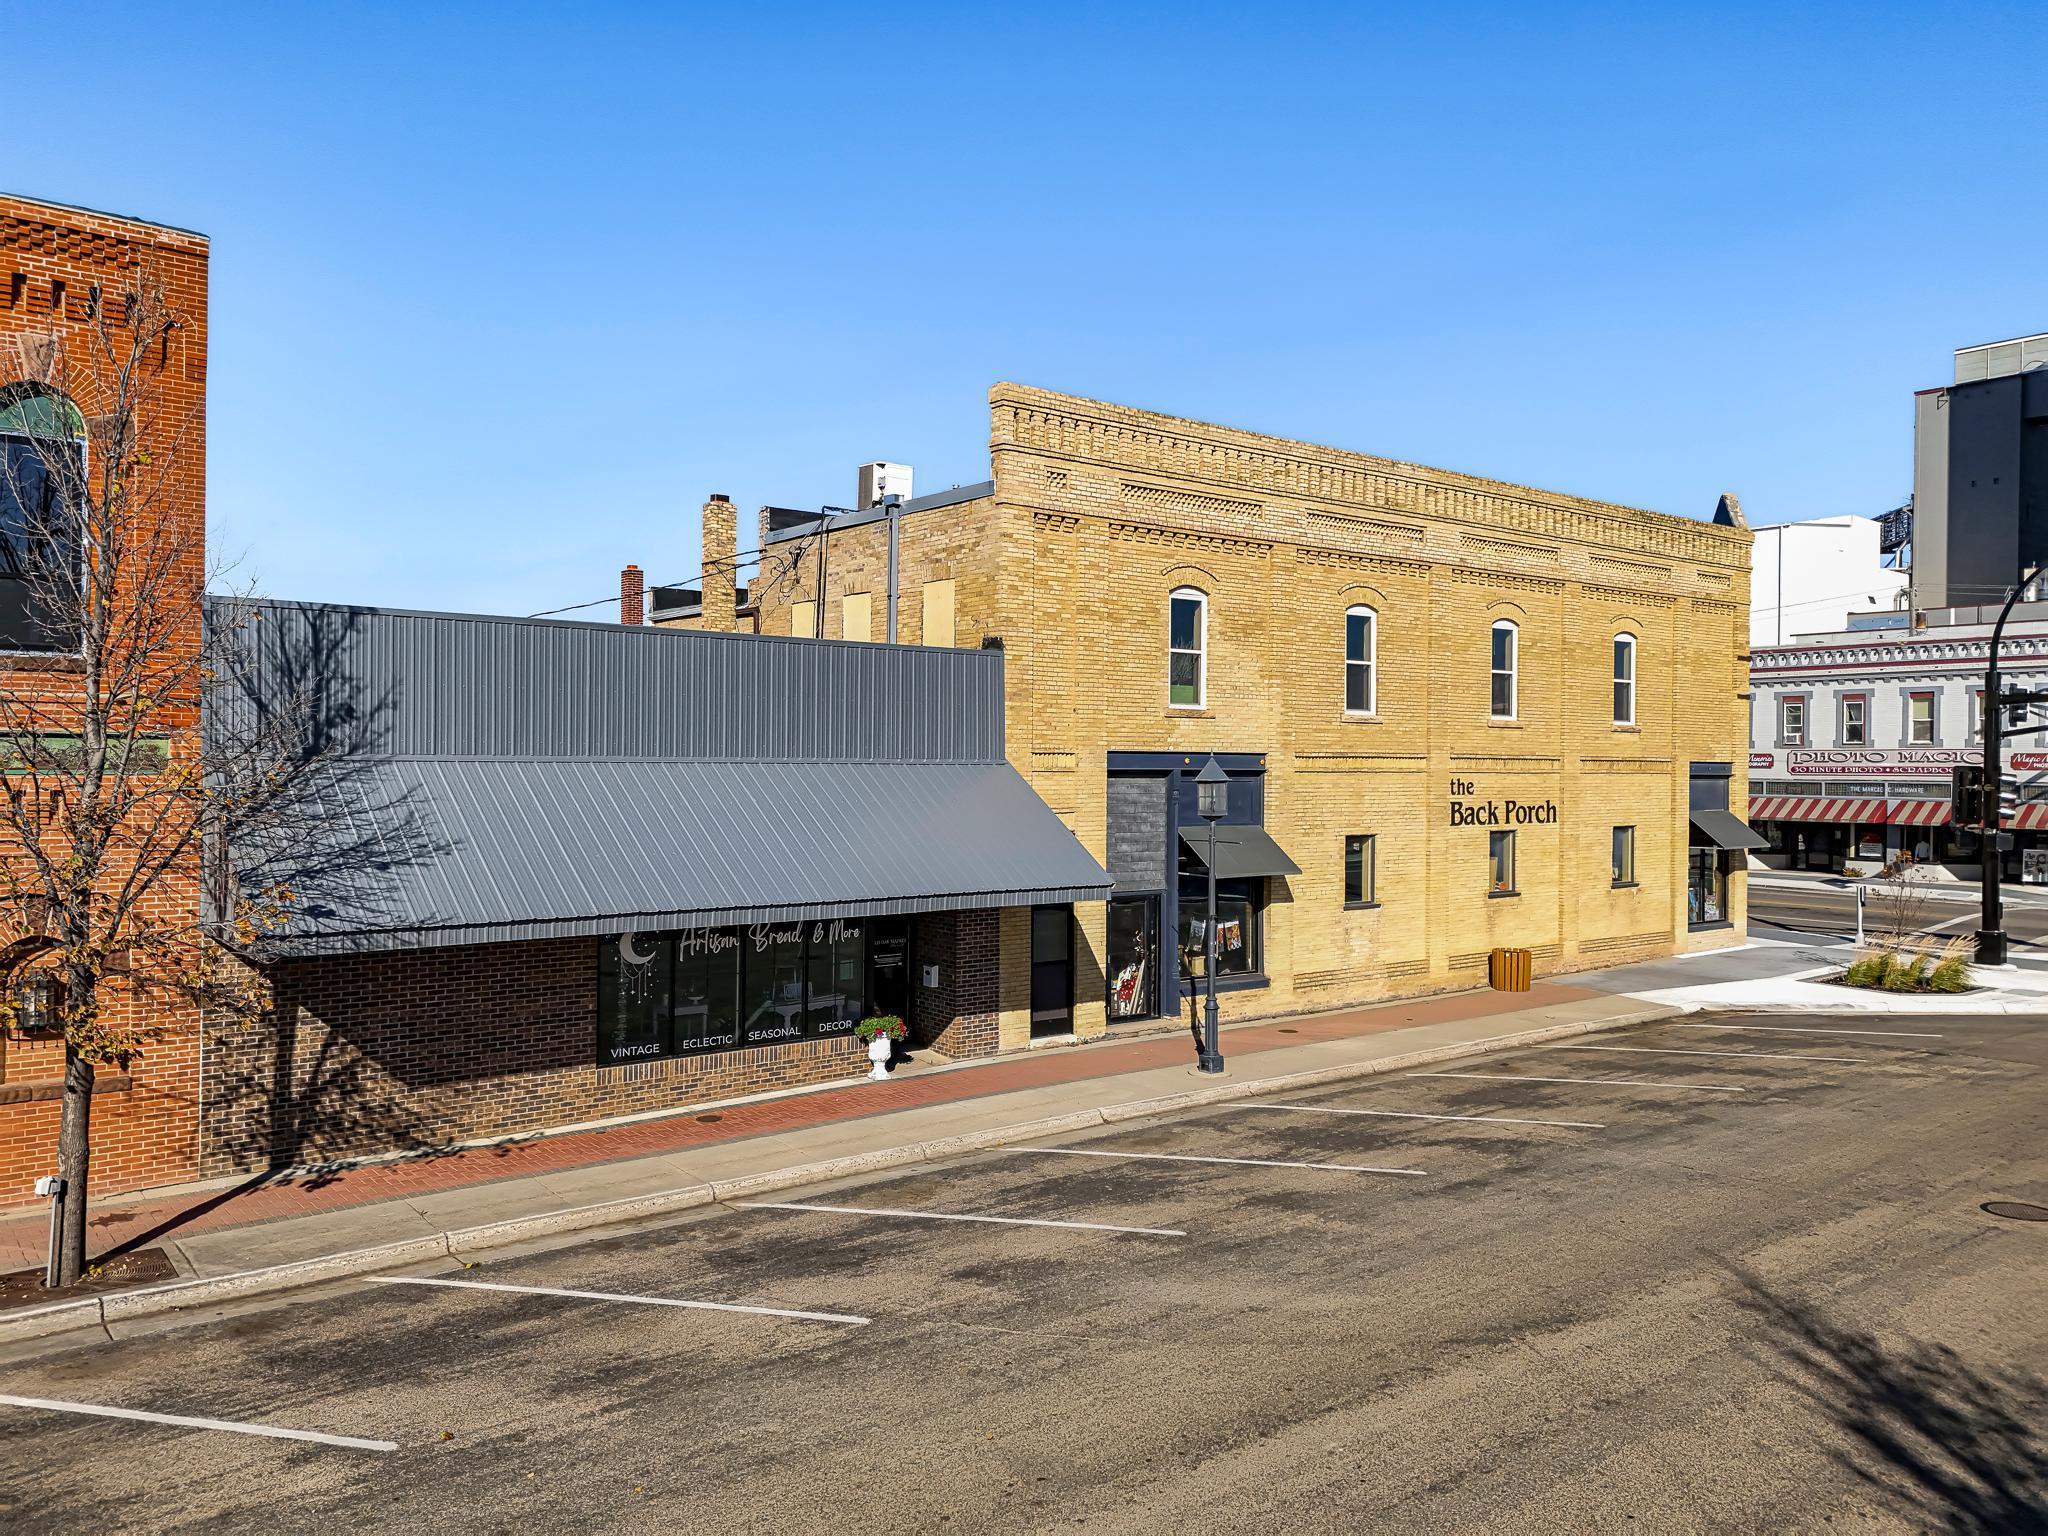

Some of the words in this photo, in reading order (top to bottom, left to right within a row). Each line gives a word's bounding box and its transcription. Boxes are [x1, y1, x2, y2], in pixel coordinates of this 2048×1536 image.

[1793, 751, 1888, 765] PHOTO
[1898, 751, 1985, 765] MAGIC
[1450, 778, 1475, 796] the
[1450, 801, 1500, 827] Back
[1504, 799, 1558, 825] Porch
[679, 926, 740, 962] Artisan
[748, 920, 804, 953] Bread
[829, 919, 860, 945] More
[611, 1043, 660, 1059] VINTAGE
[683, 1034, 733, 1049] ECLECTIC
[748, 1026, 801, 1041] SEASONAL
[818, 1019, 853, 1033] DECOR
